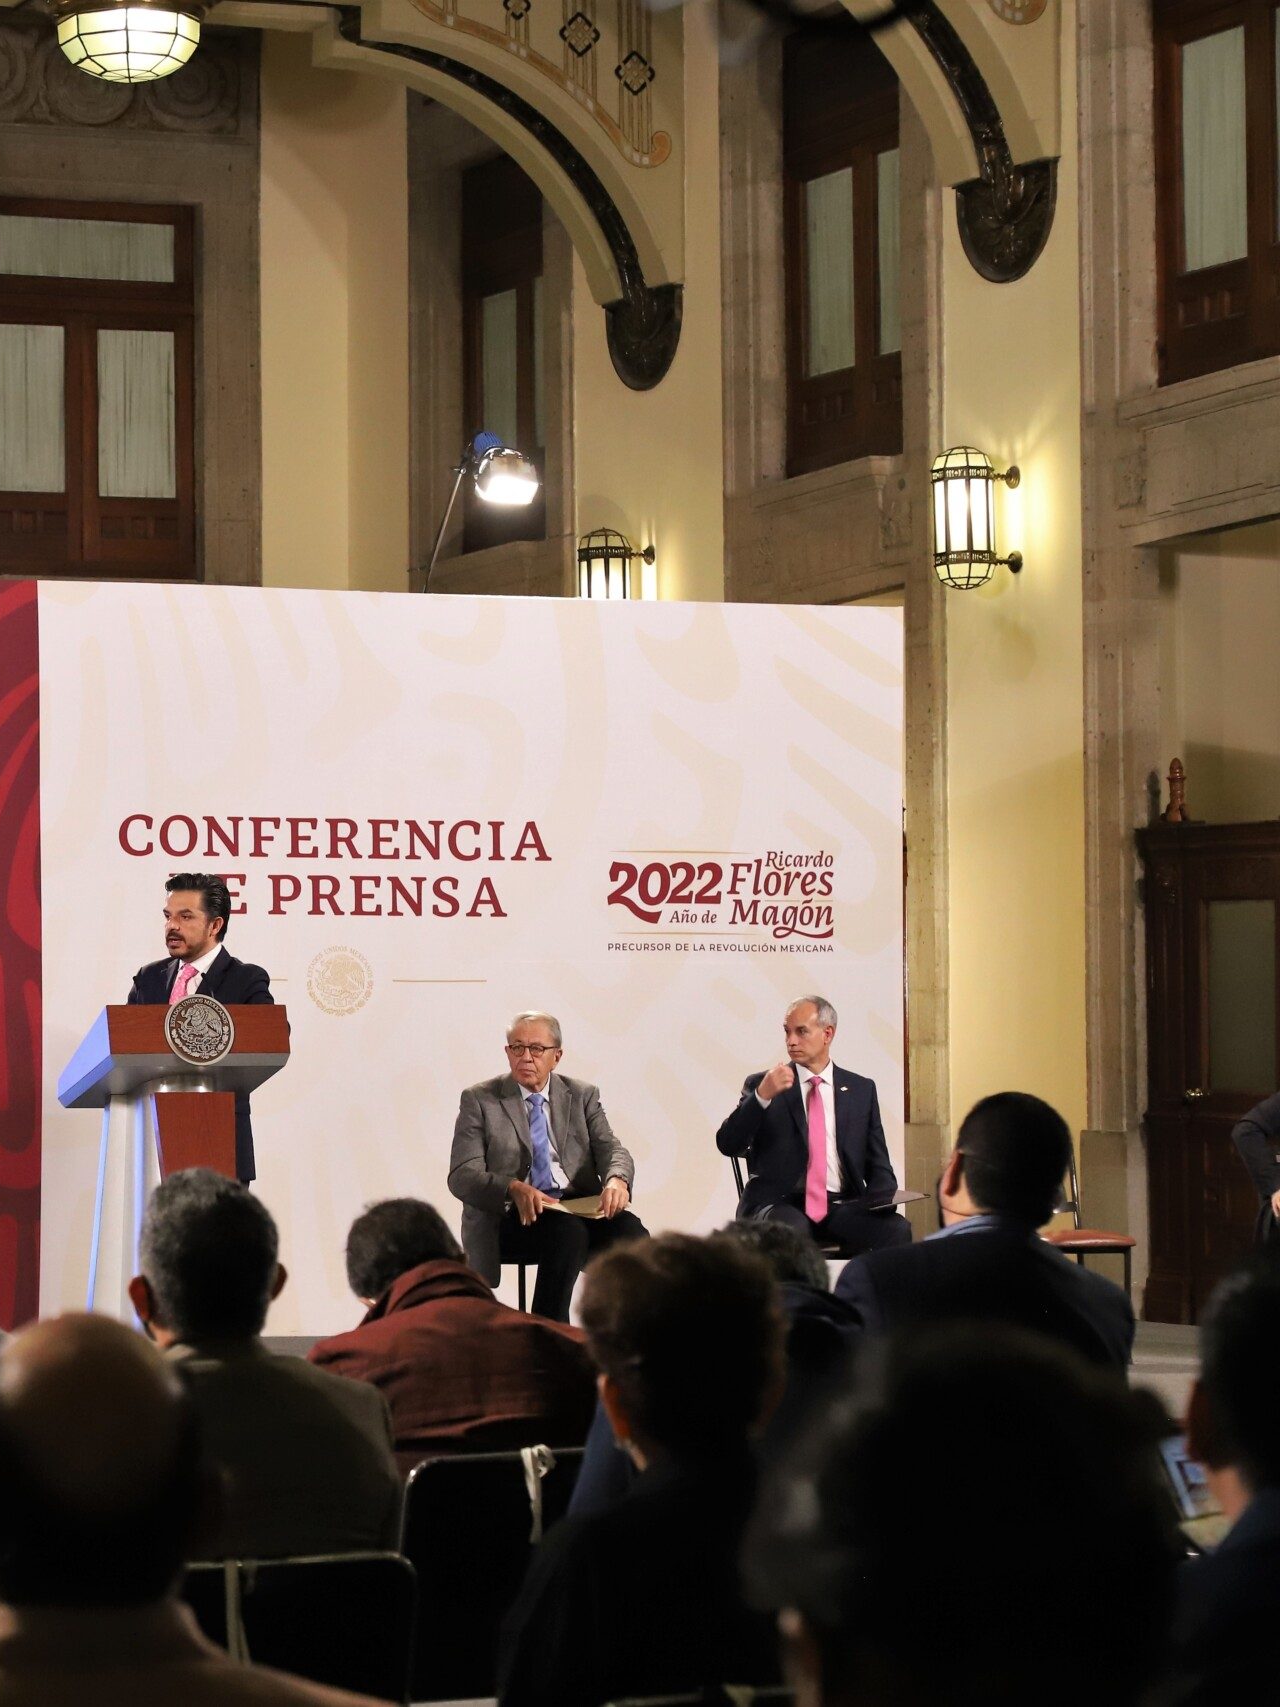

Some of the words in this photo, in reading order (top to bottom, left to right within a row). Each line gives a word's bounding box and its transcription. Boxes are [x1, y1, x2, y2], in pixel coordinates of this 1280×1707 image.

[119, 814, 552, 861] CONFERENCIA
[727, 857, 834, 896] Flores
[765, 850, 833, 871] Ricardo
[169, 873, 247, 914] E
[268, 875, 507, 917] PRENSA
[607, 861, 723, 924] 2022
[669, 910, 697, 923] Año
[702, 910, 717, 923] de
[729, 898, 834, 939] Magón
[607, 942, 672, 952] PRECURSOR
[675, 942, 689, 952] DE
[692, 943, 706, 952] LA
[709, 942, 777, 953] REVOLUCIÓN
[780, 944, 834, 953] MEXICANA
